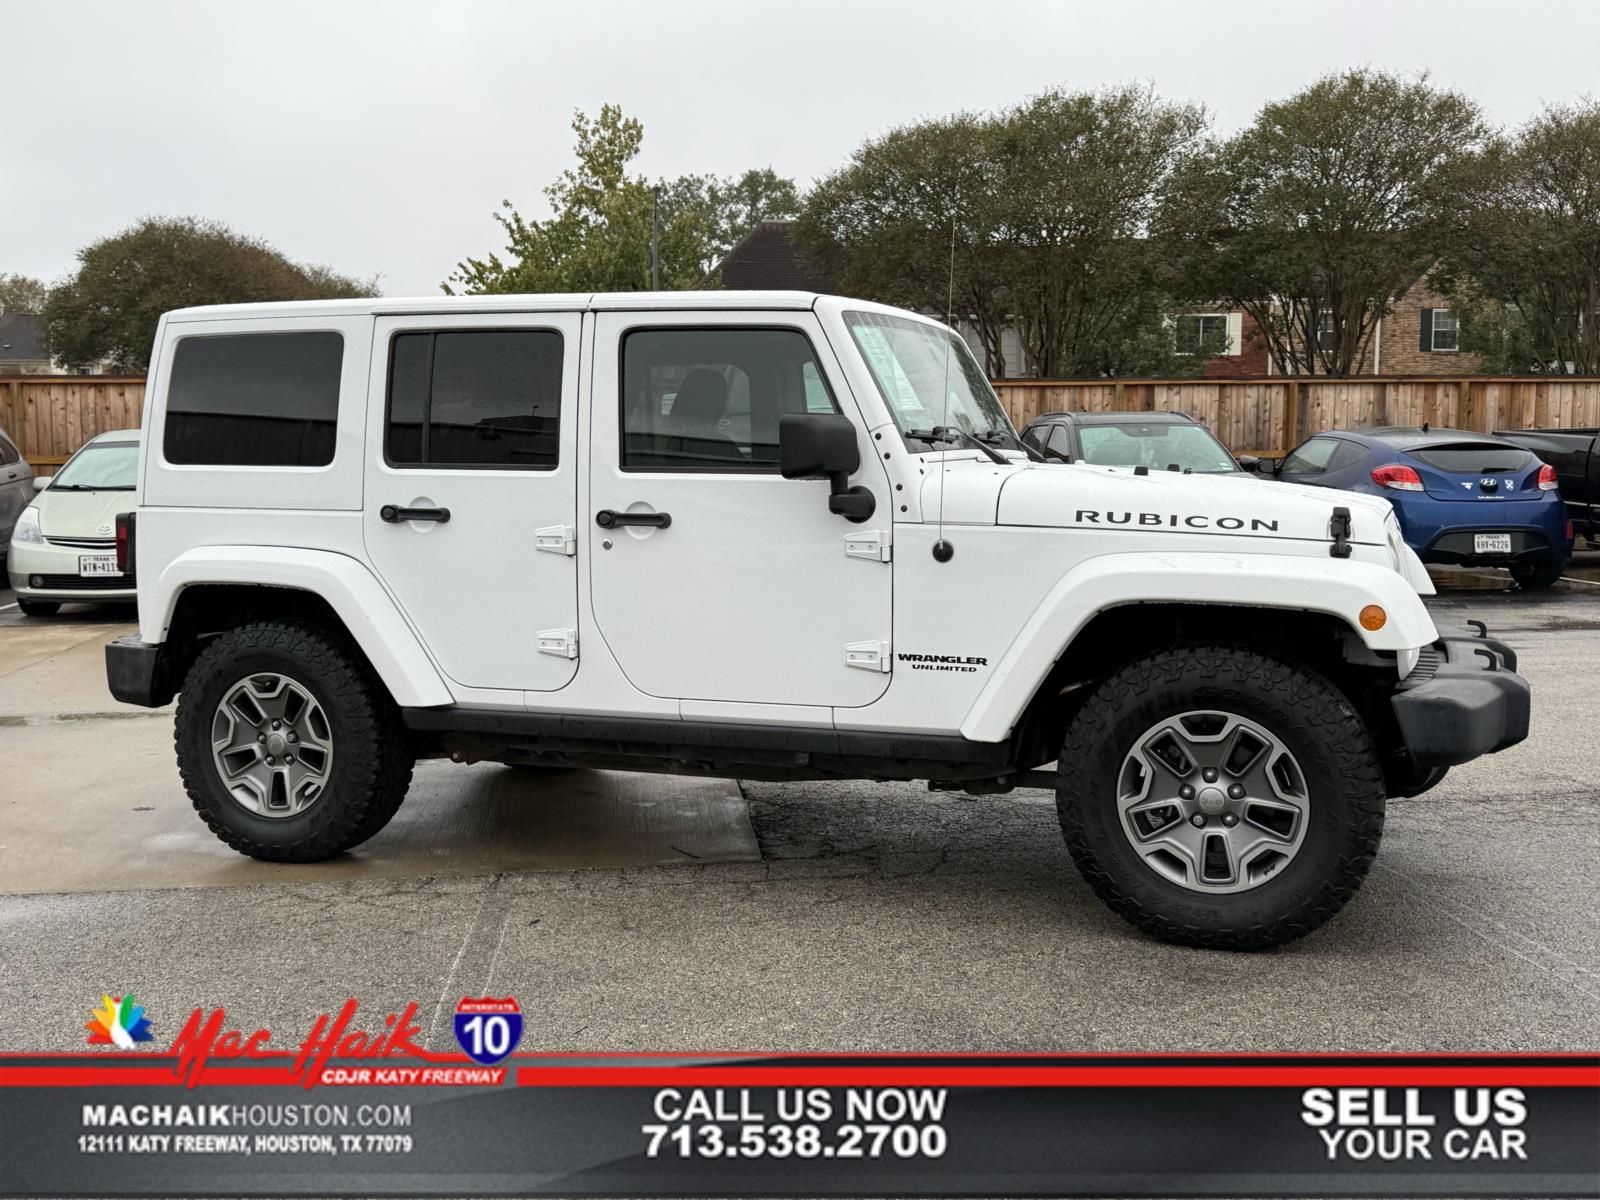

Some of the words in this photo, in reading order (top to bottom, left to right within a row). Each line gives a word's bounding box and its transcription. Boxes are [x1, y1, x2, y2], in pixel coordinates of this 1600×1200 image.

[1075, 509, 1279, 531] RUBICON
[898, 653, 988, 666] WRANGLER
[912, 664, 977, 673] UNLIMITED
